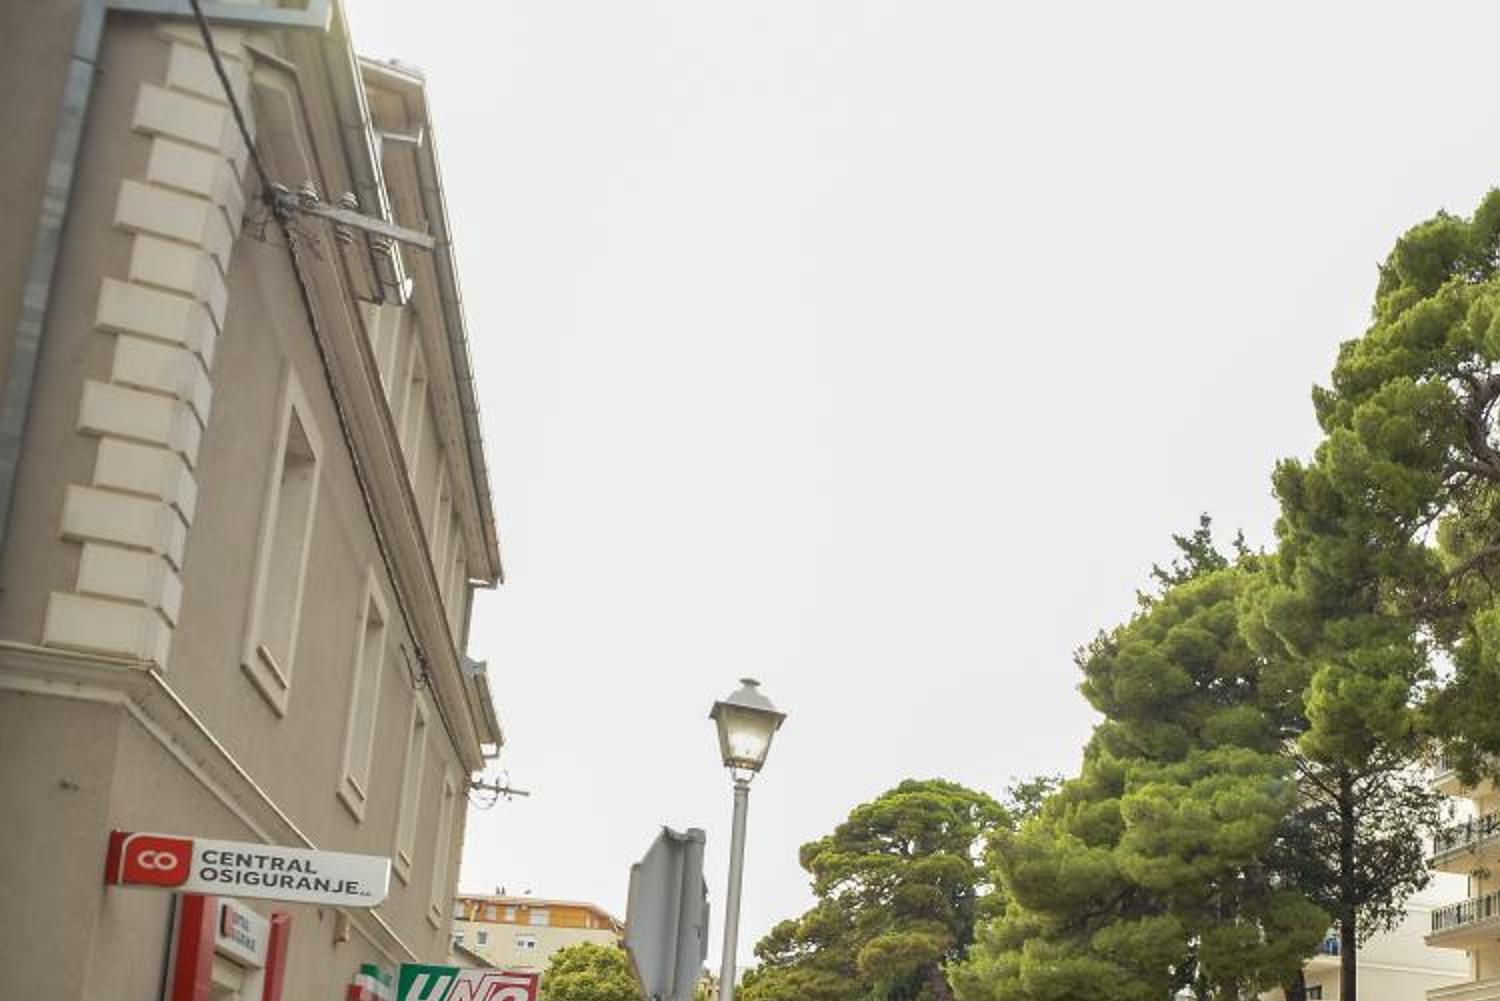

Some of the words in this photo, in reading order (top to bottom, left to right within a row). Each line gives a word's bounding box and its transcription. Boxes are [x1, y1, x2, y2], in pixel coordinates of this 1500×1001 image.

[137, 850, 178, 871] CO
[201, 850, 318, 875] CENTRAL
[199, 867, 359, 896] OSIGURANJE
